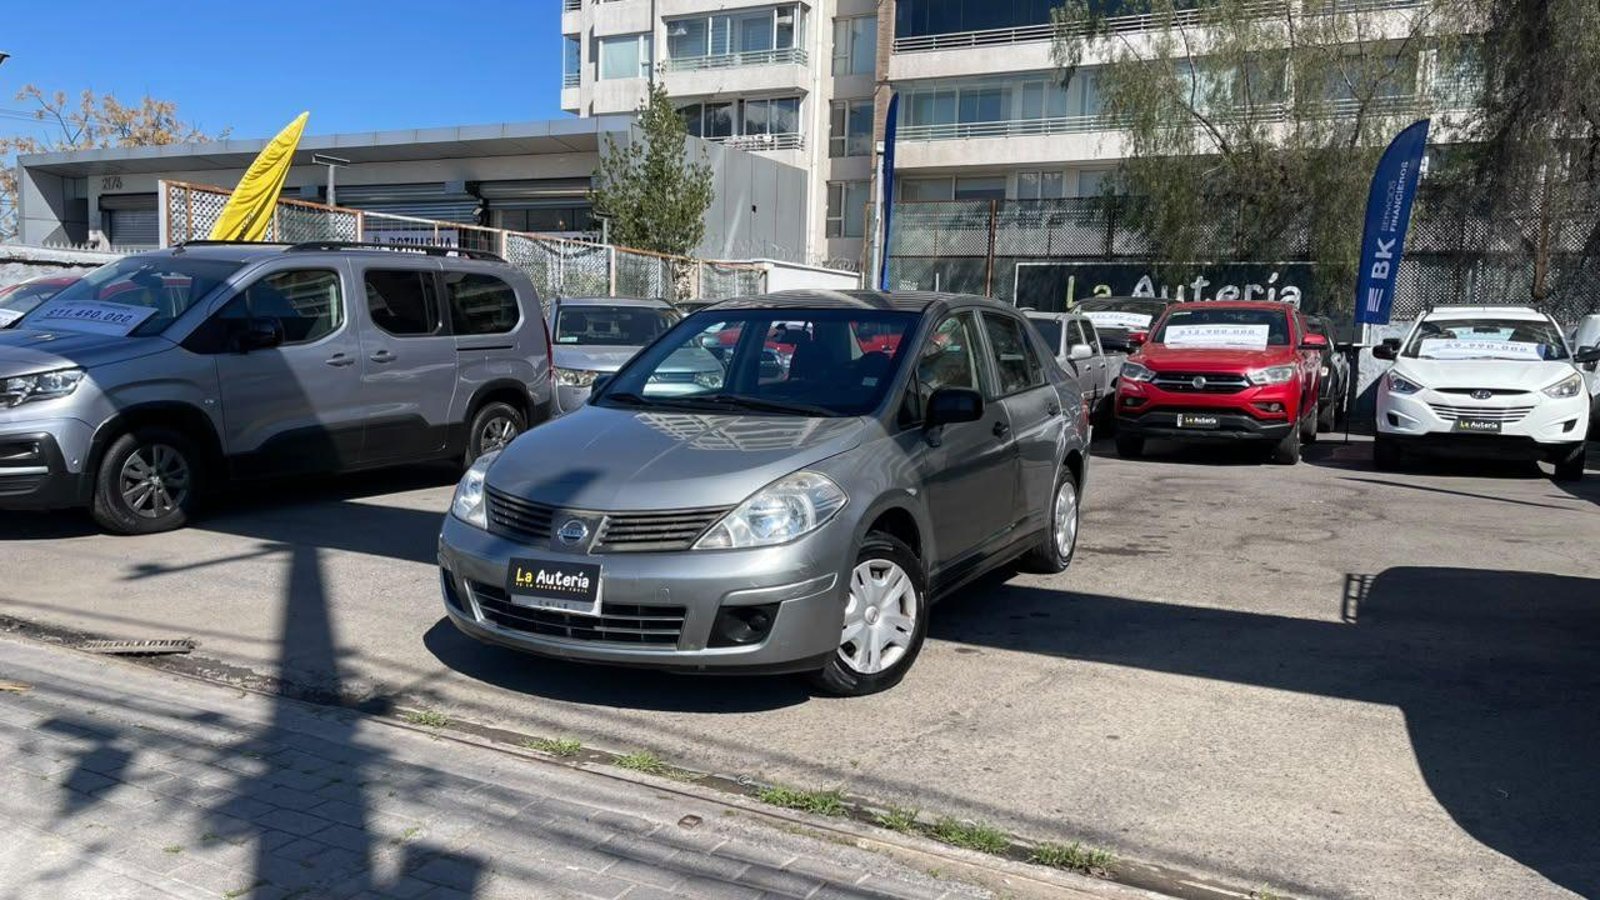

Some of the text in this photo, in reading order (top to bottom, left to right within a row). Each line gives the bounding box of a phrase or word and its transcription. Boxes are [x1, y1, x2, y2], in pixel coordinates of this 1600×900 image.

[1390, 161, 1409, 232] FINANCIEROS
[1371, 237, 1397, 279] BK
[1066, 271, 1302, 309] La Autería
[515, 567, 533, 582] La
[535, 569, 589, 588] Autería
